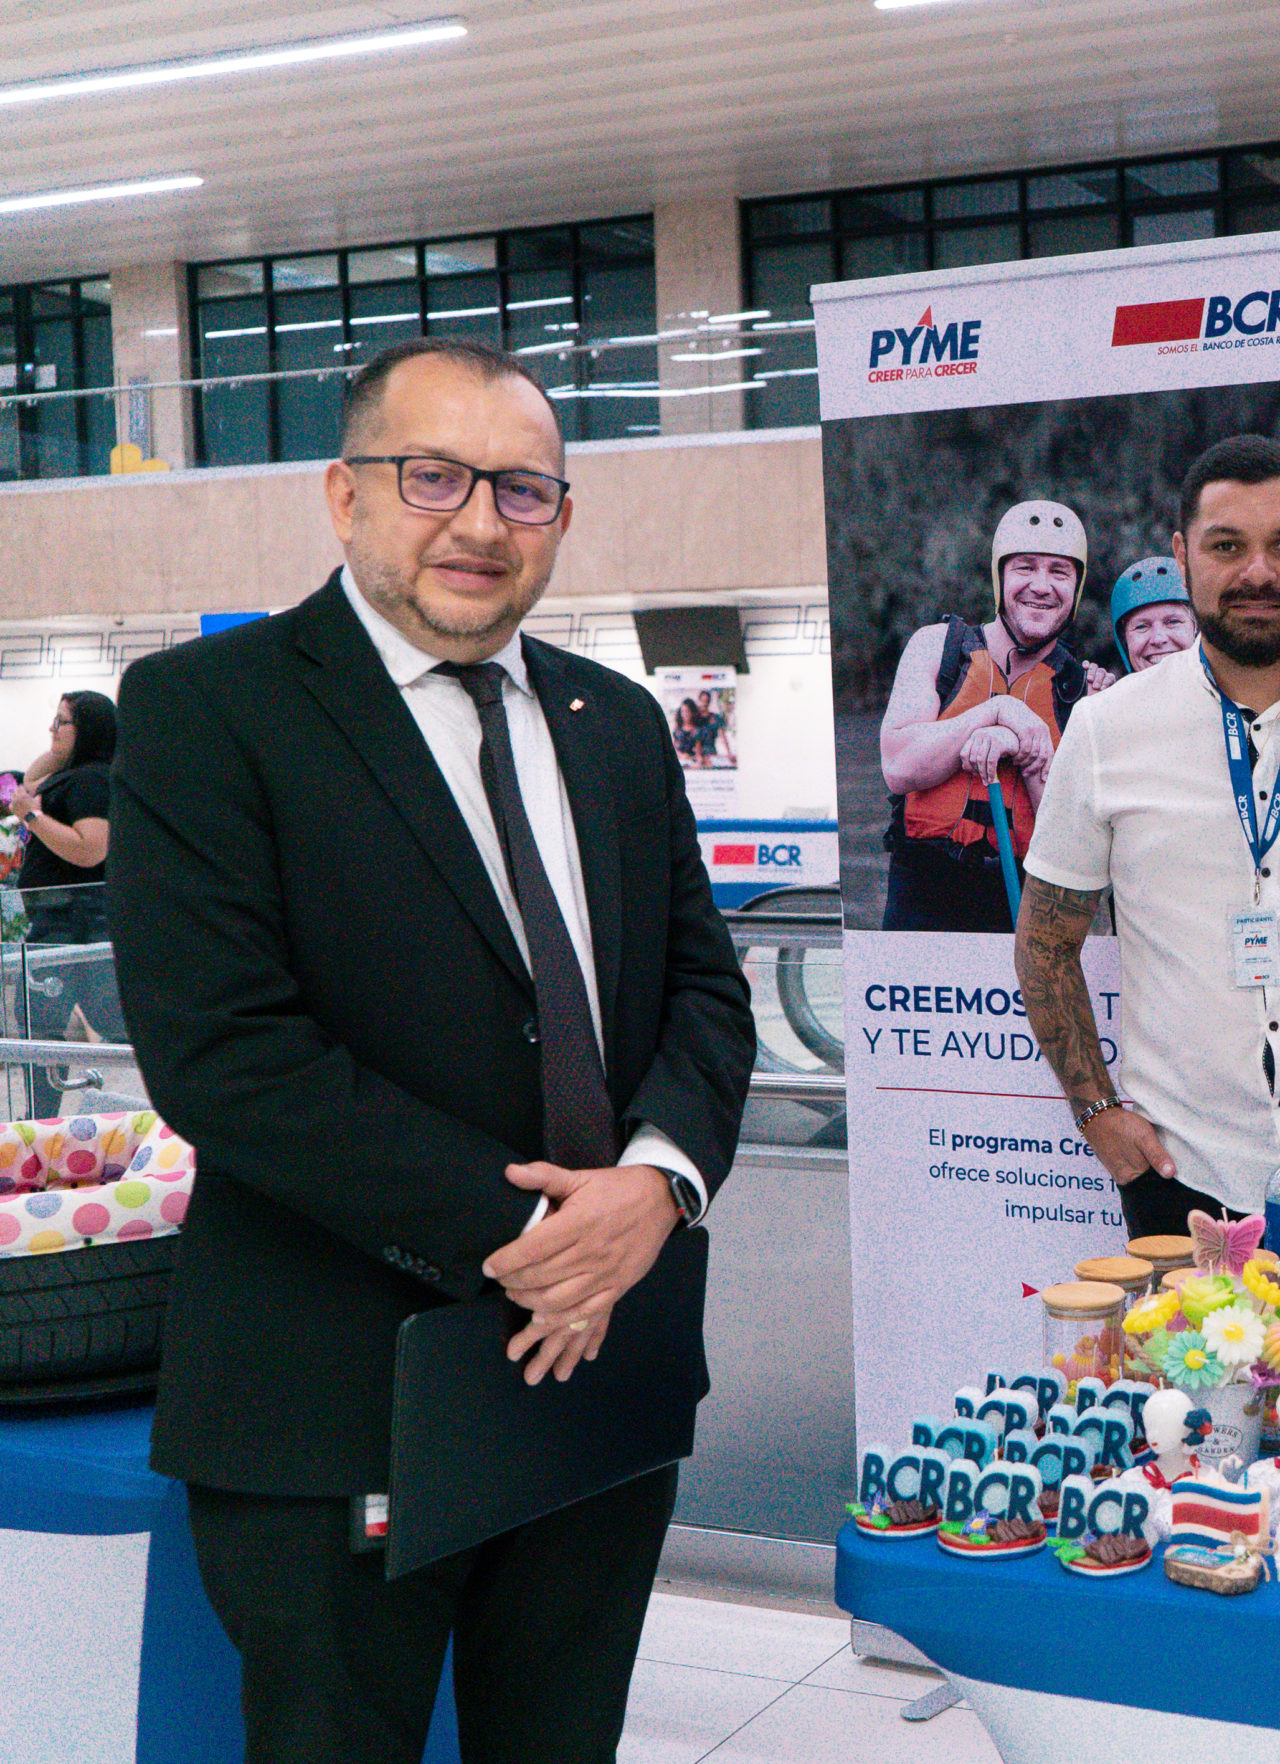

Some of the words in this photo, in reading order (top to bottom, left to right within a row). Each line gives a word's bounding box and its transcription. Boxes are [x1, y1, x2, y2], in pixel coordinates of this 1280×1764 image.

[869, 320, 982, 368] PYME
[1157, 344, 1188, 355] SOMOS
[1190, 344, 1198, 352] EL
[1202, 340, 1233, 351] BANCO
[1234, 339, 1245, 348] DE
[1247, 337, 1274, 347] COSTA
[868, 369, 904, 384] CREER
[905, 367, 933, 380] PARA
[934, 362, 977, 377] CRECER
[1227, 712, 1239, 736] BCR
[1238, 794, 1248, 819] BCR
[758, 845, 802, 866] BCR
[1244, 936, 1268, 946] PYME
[862, 1027, 882, 1054] Y
[891, 1028, 932, 1056] TE
[929, 1129, 945, 1146] El
[951, 1133, 1053, 1154] programa
[929, 1161, 990, 1183] ofrece
[995, 1167, 1104, 1191] soluciones
[1005, 1199, 1095, 1224] impulsar
[1100, 1209, 1123, 1227] tu
[860, 1453, 945, 1509] BCR
[946, 1471, 1035, 1521] BCR
[1060, 1486, 1149, 1539] BCR
